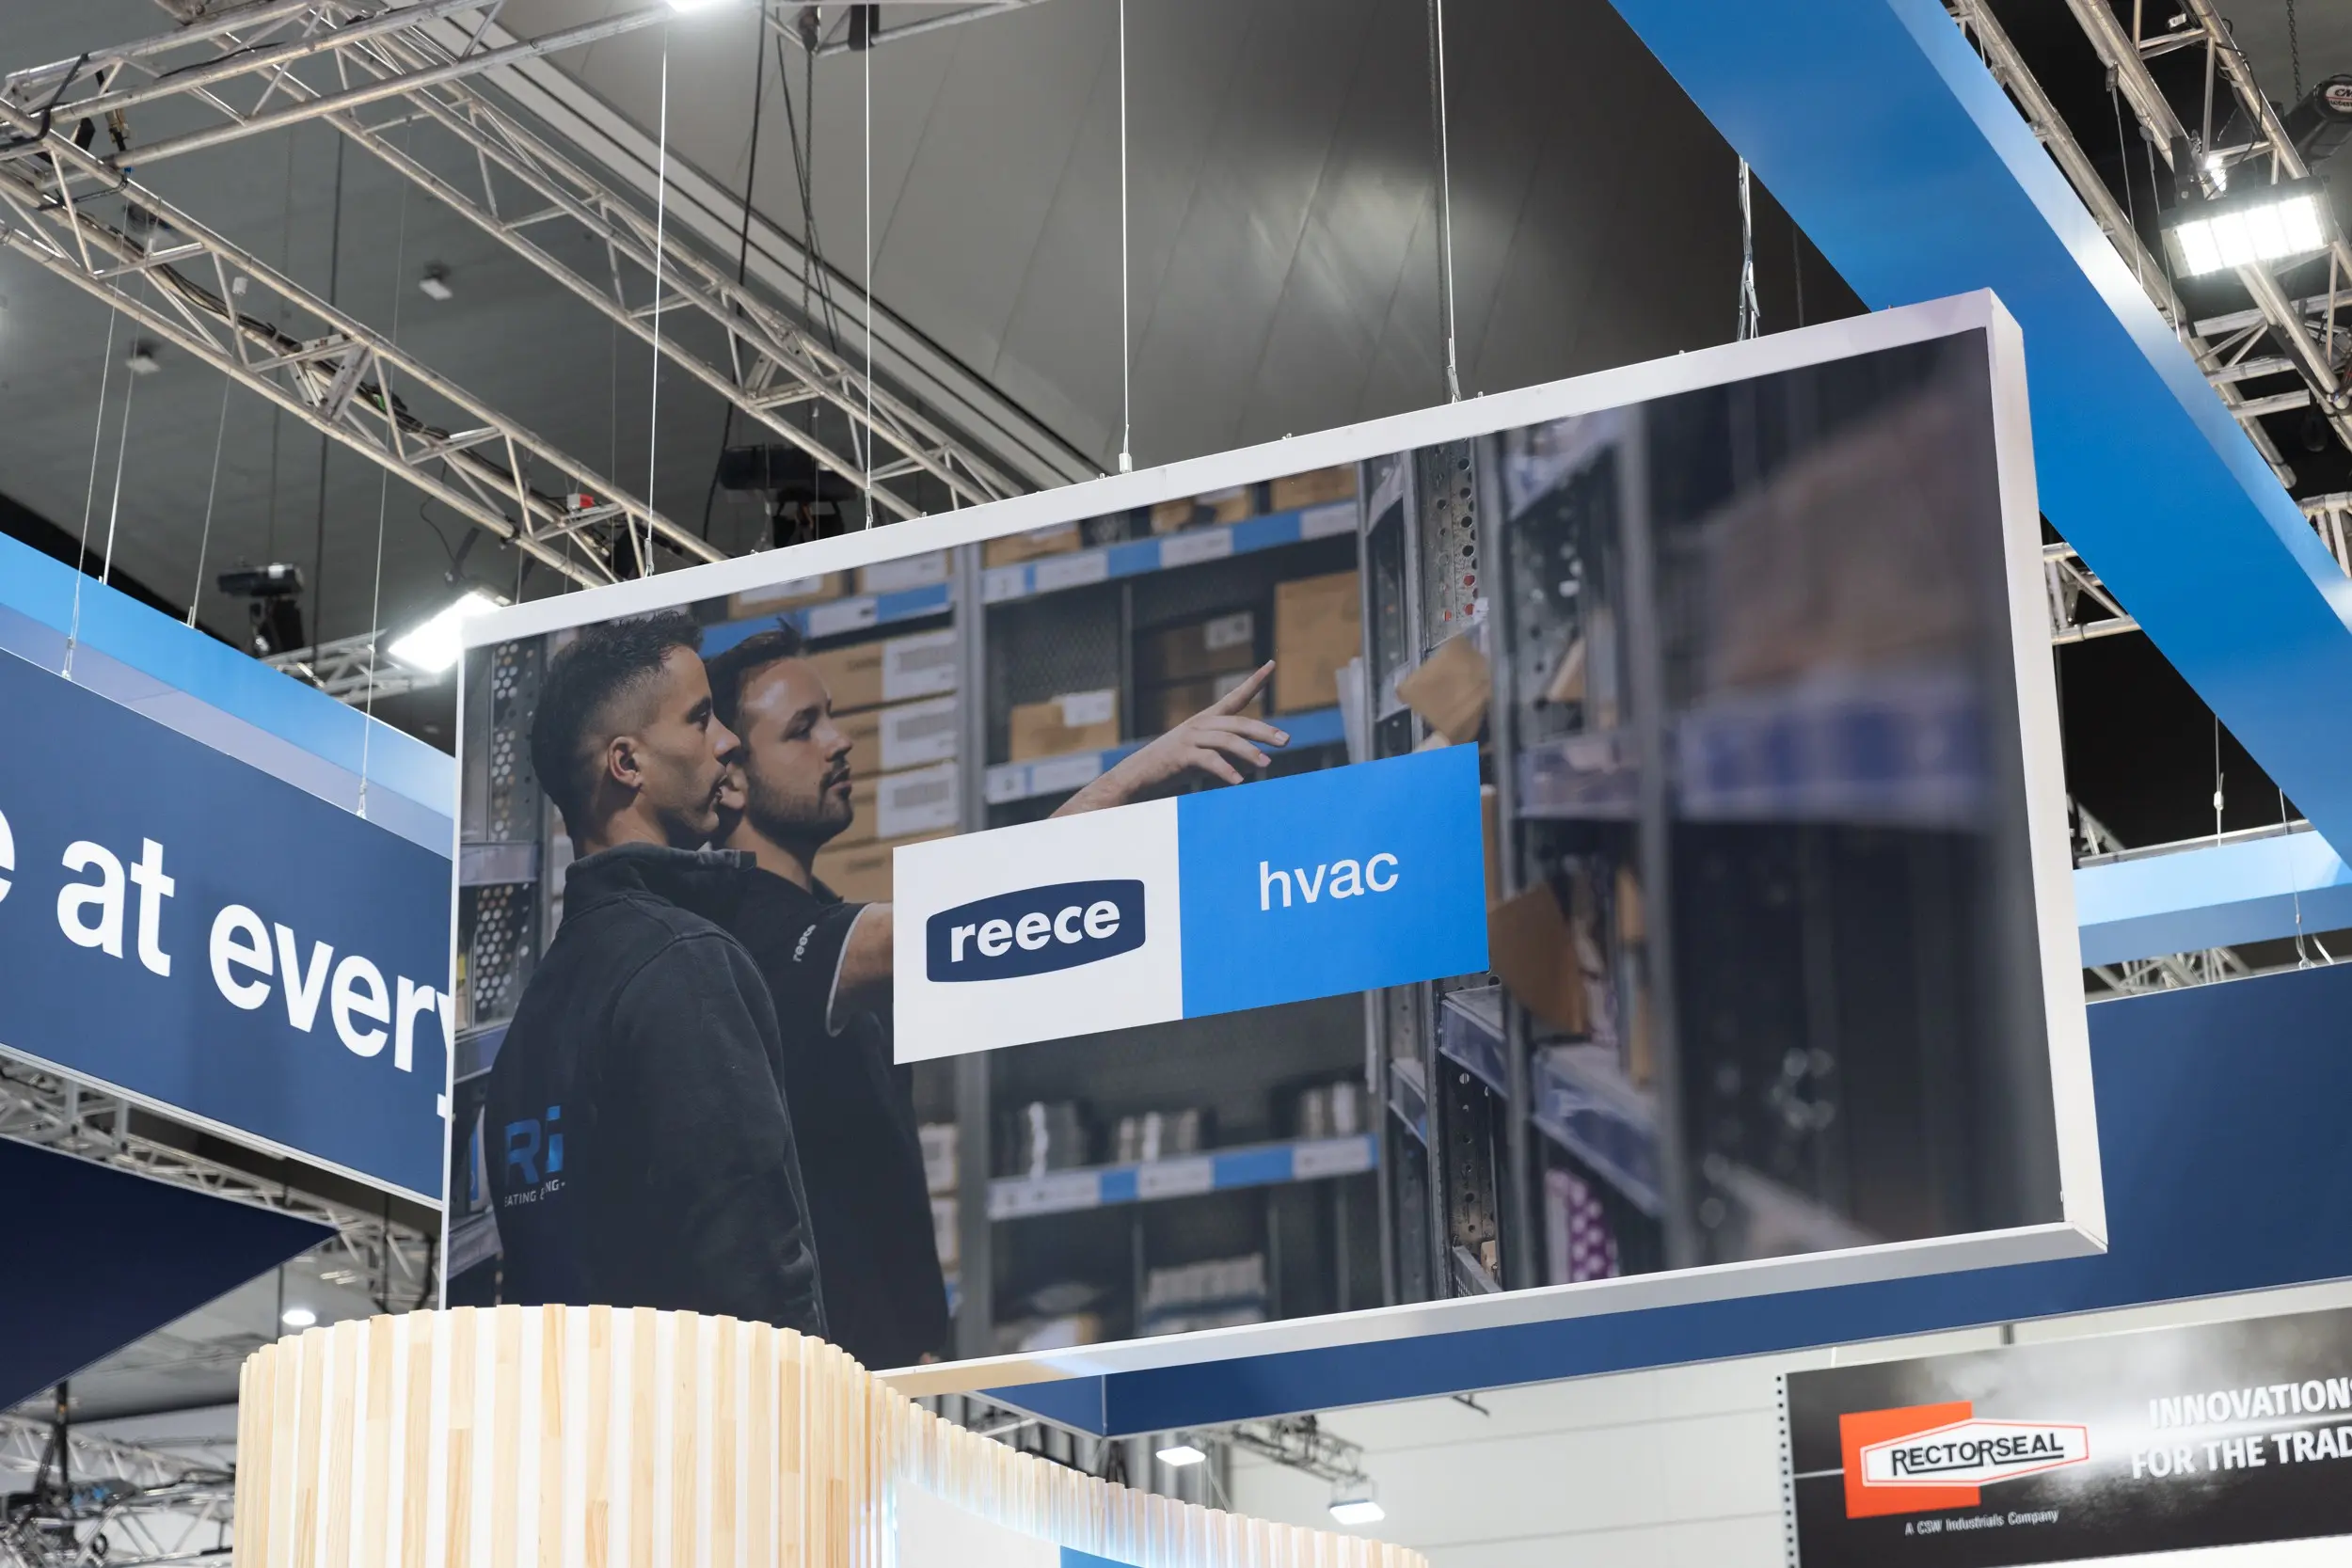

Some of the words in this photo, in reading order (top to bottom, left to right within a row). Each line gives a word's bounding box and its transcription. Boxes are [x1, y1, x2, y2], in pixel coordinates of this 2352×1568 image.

[950, 900, 1120, 963] reece
[1259, 852, 1400, 911] hvac
[57, 837, 175, 977] at
[210, 904, 451, 1118] ever
[504, 1190, 536, 1207] ATING
[2149, 1377, 2352, 1428] INNOVATION
[1891, 1433, 2064, 1476] RECTORSEAL
[2131, 1445, 2197, 1480] FOR
[2202, 1435, 2266, 1471] THE
[1904, 1522, 1915, 1536] A
[1916, 1519, 1942, 1535] CSW
[1946, 1513, 2005, 1532] Industrials
[2007, 1509, 2059, 1525] Company
